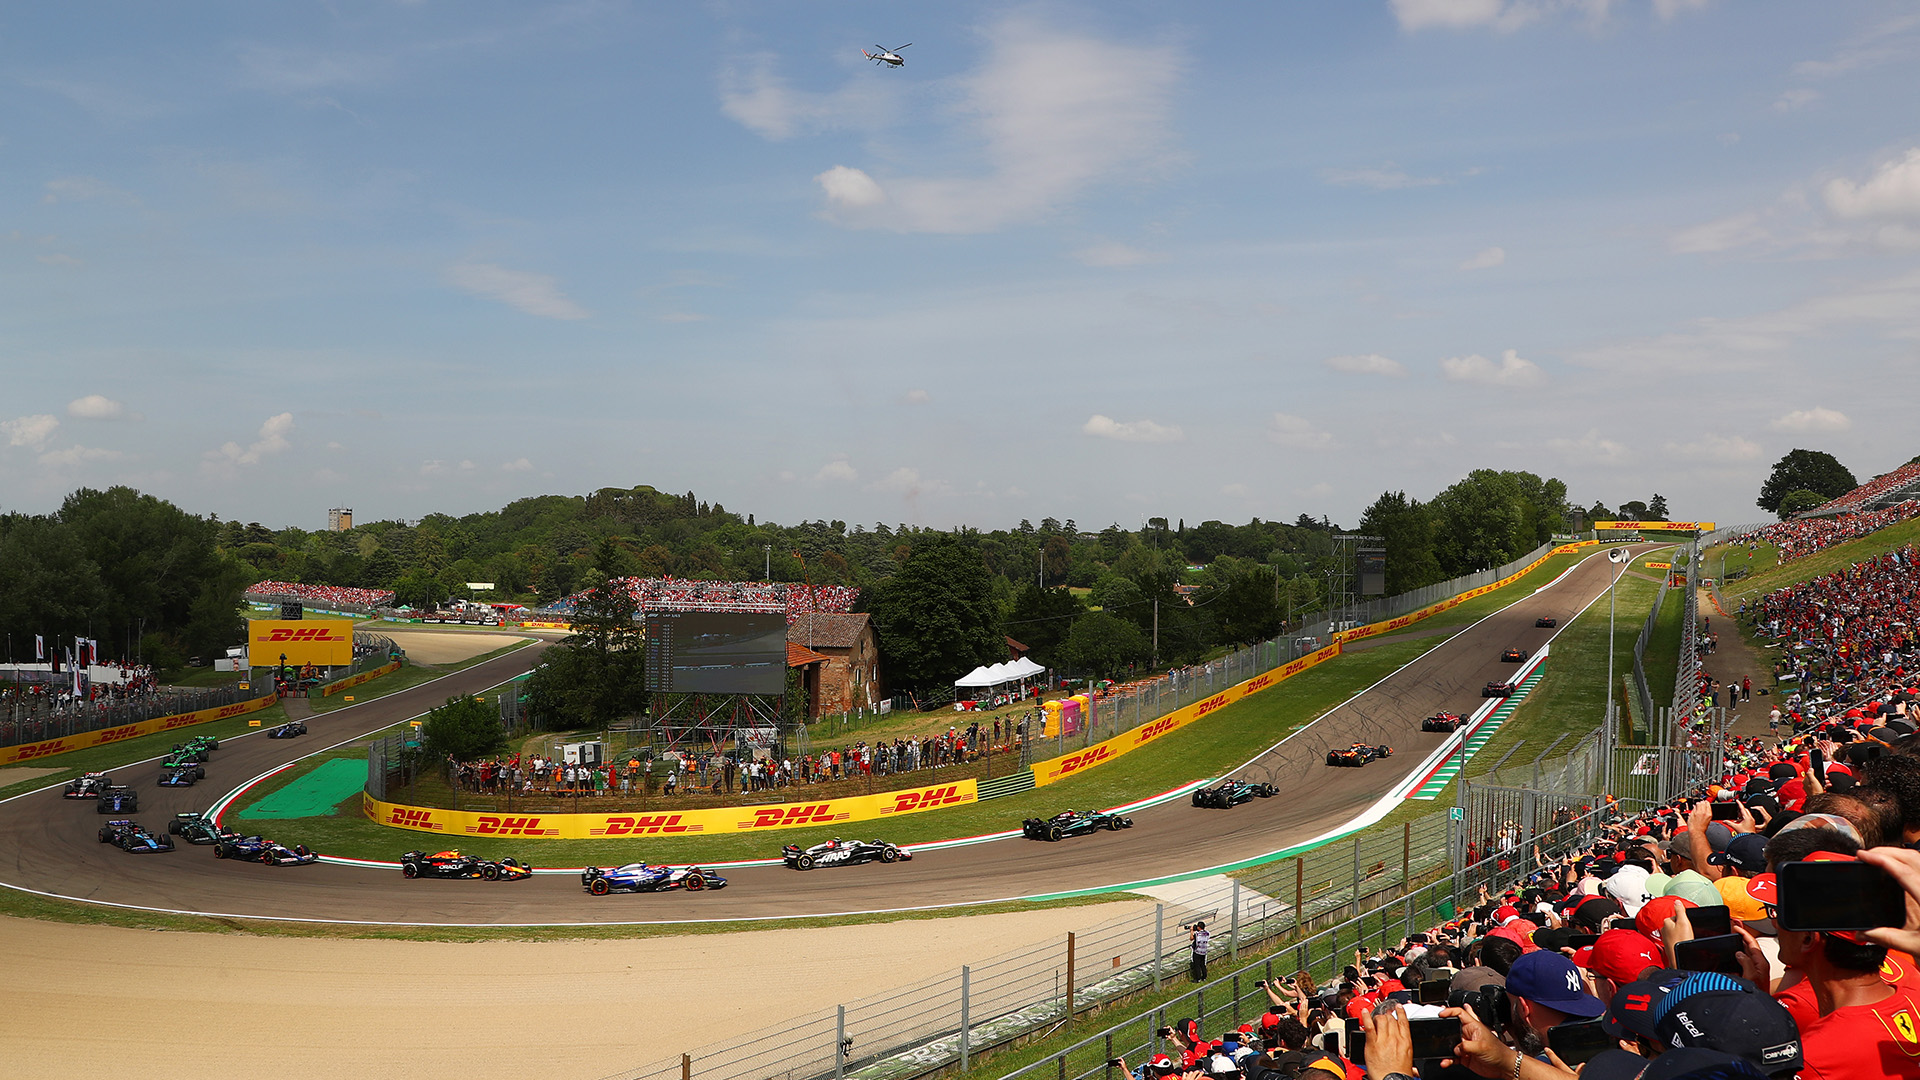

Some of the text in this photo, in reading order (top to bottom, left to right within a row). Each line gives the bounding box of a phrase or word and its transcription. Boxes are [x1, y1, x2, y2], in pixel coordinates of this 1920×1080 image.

[1347, 626, 1373, 641] DHL
[1388, 617, 1410, 630] DHL
[269, 628, 334, 642] DHL
[1316, 647, 1334, 661] DHL
[1285, 660, 1305, 676] DHL
[1247, 675, 1270, 693] DHL
[219, 704, 247, 717] DHL
[1197, 694, 1227, 715] DHL
[165, 714, 199, 728] DHL
[1139, 717, 1176, 742] DHL
[100, 725, 141, 743] DHL
[17, 740, 66, 760] DHL
[1058, 745, 1111, 775] DHL
[892, 785, 963, 812] DHL
[391, 807, 434, 829] DHL
[475, 816, 546, 836] DHL
[604, 814, 689, 835] DHL
[752, 804, 837, 828] DHL
[1564, 969, 1582, 992] NY
[1676, 1011, 1705, 1038] telcel
